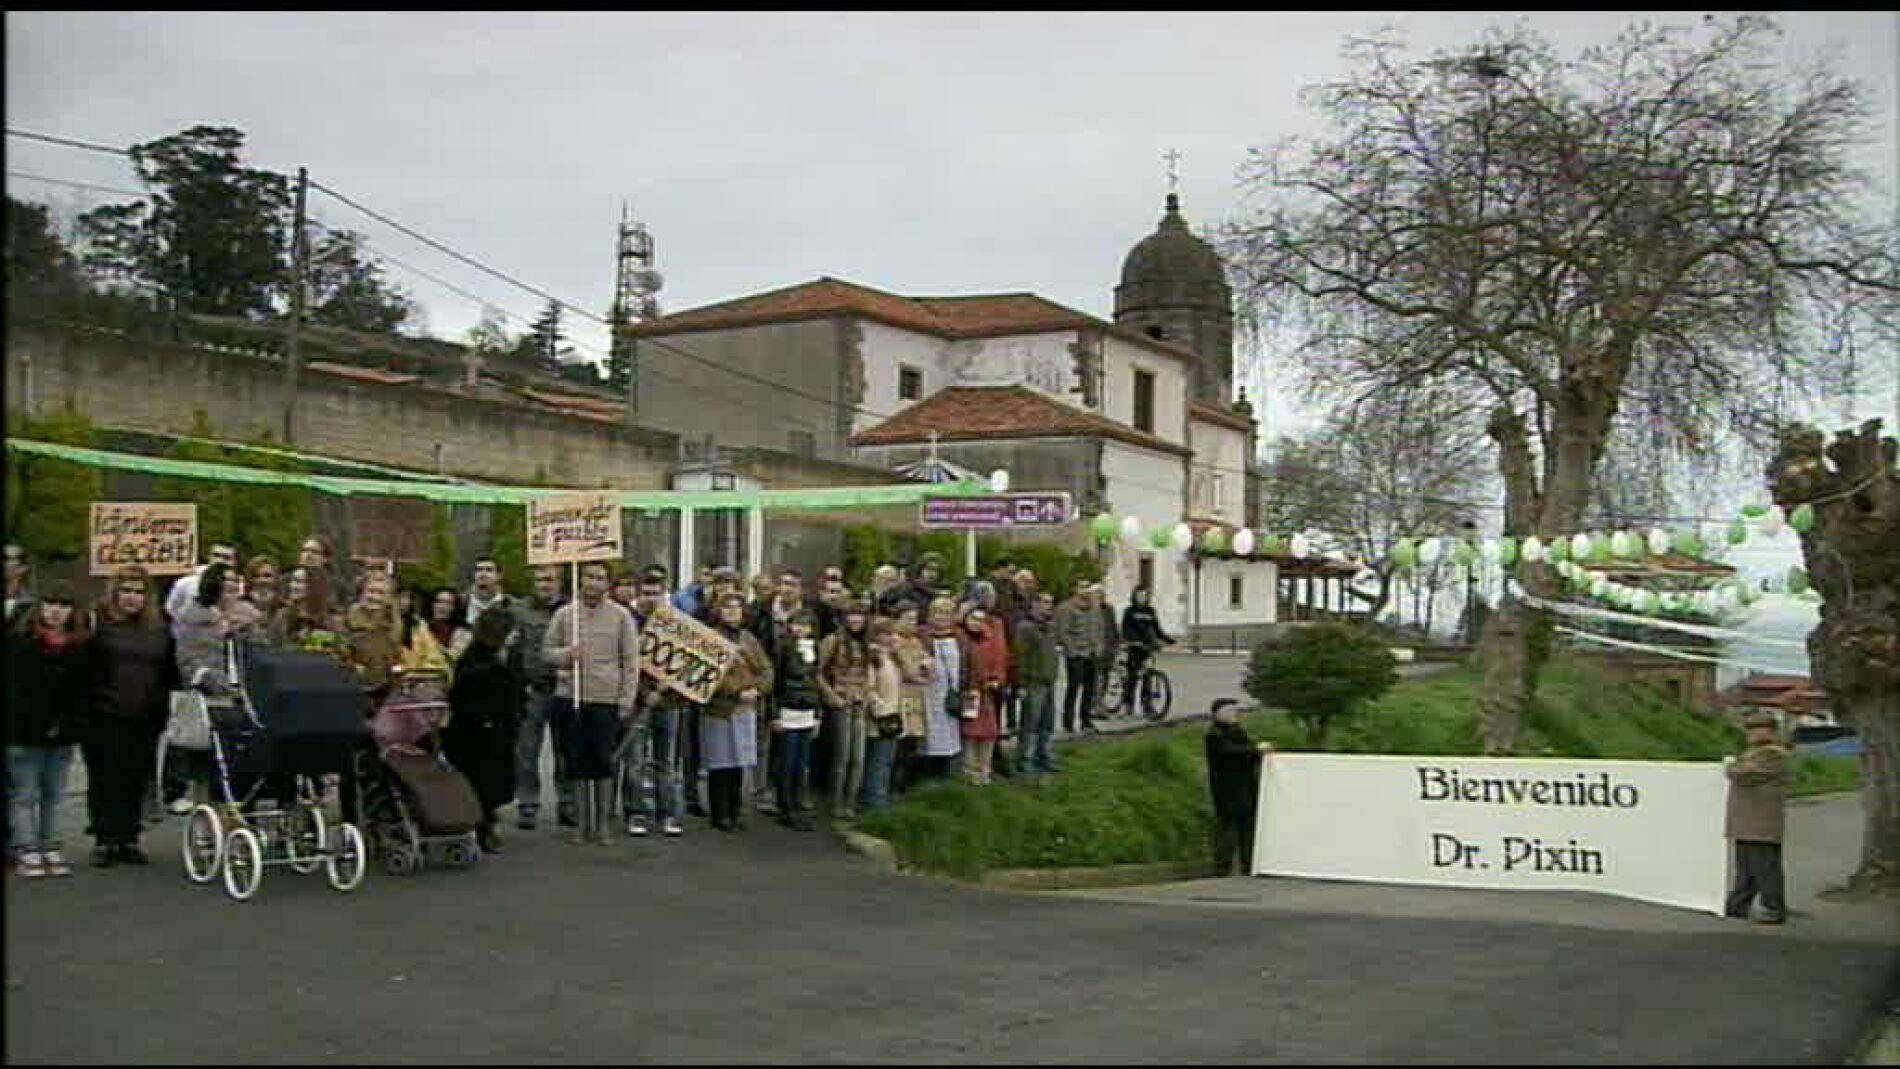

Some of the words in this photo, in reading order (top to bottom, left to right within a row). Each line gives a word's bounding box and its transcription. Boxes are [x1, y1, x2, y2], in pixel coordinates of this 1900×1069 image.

[1417, 767, 1639, 808] Bienvenido
[1432, 833, 1489, 868] Dr.
[1503, 836, 1604, 875] Pixin
